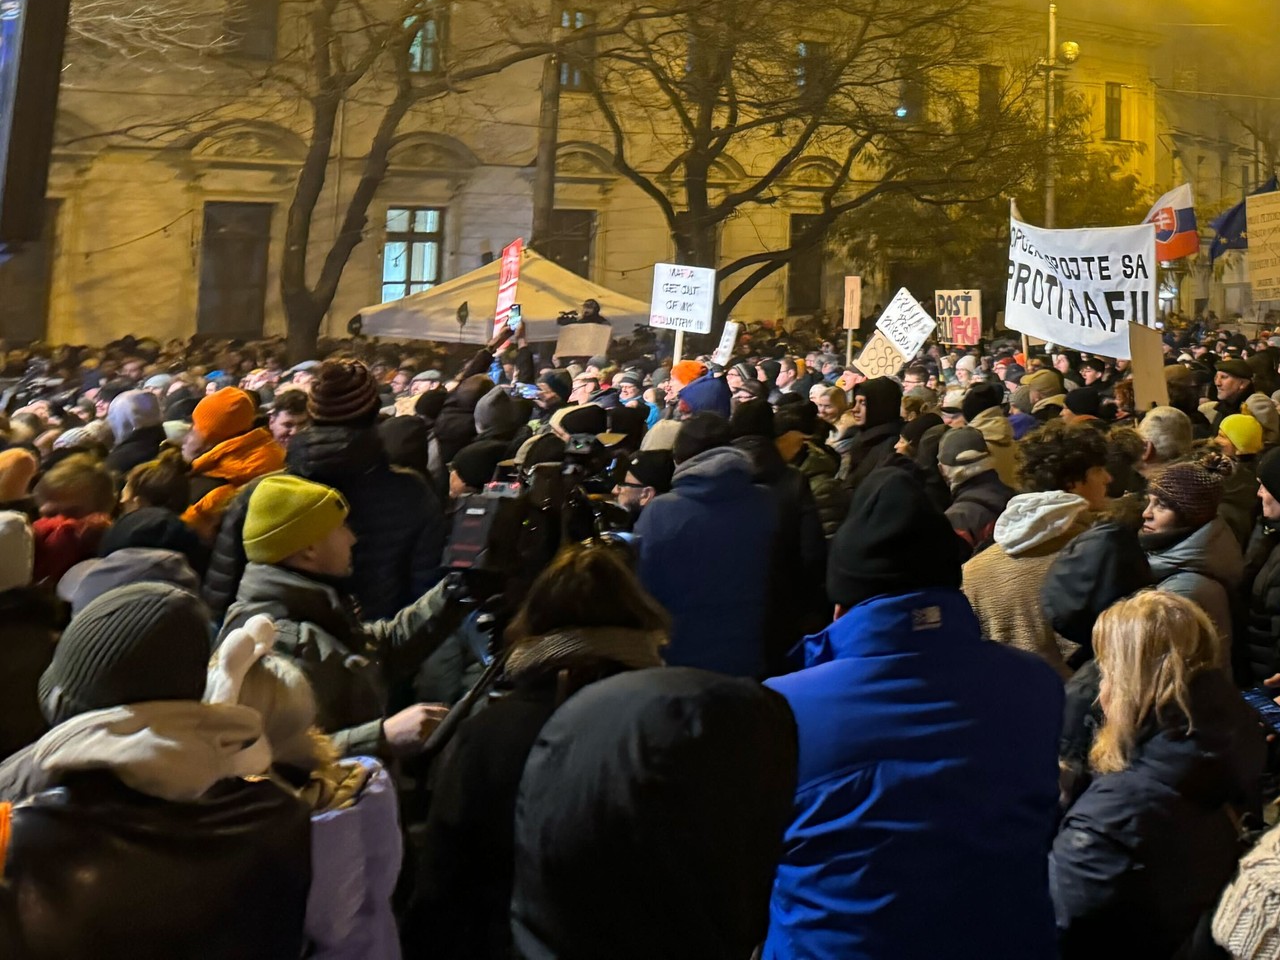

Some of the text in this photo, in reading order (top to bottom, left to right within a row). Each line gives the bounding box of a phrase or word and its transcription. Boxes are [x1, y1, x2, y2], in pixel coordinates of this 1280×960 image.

[1044, 254, 1149, 281] SPOJTE SA
[681, 285, 700, 295] OUT
[1008, 259, 1149, 333] PROTI MAFII
[666, 300, 679, 309] OF
[937, 291, 972, 316] DOSŤ
